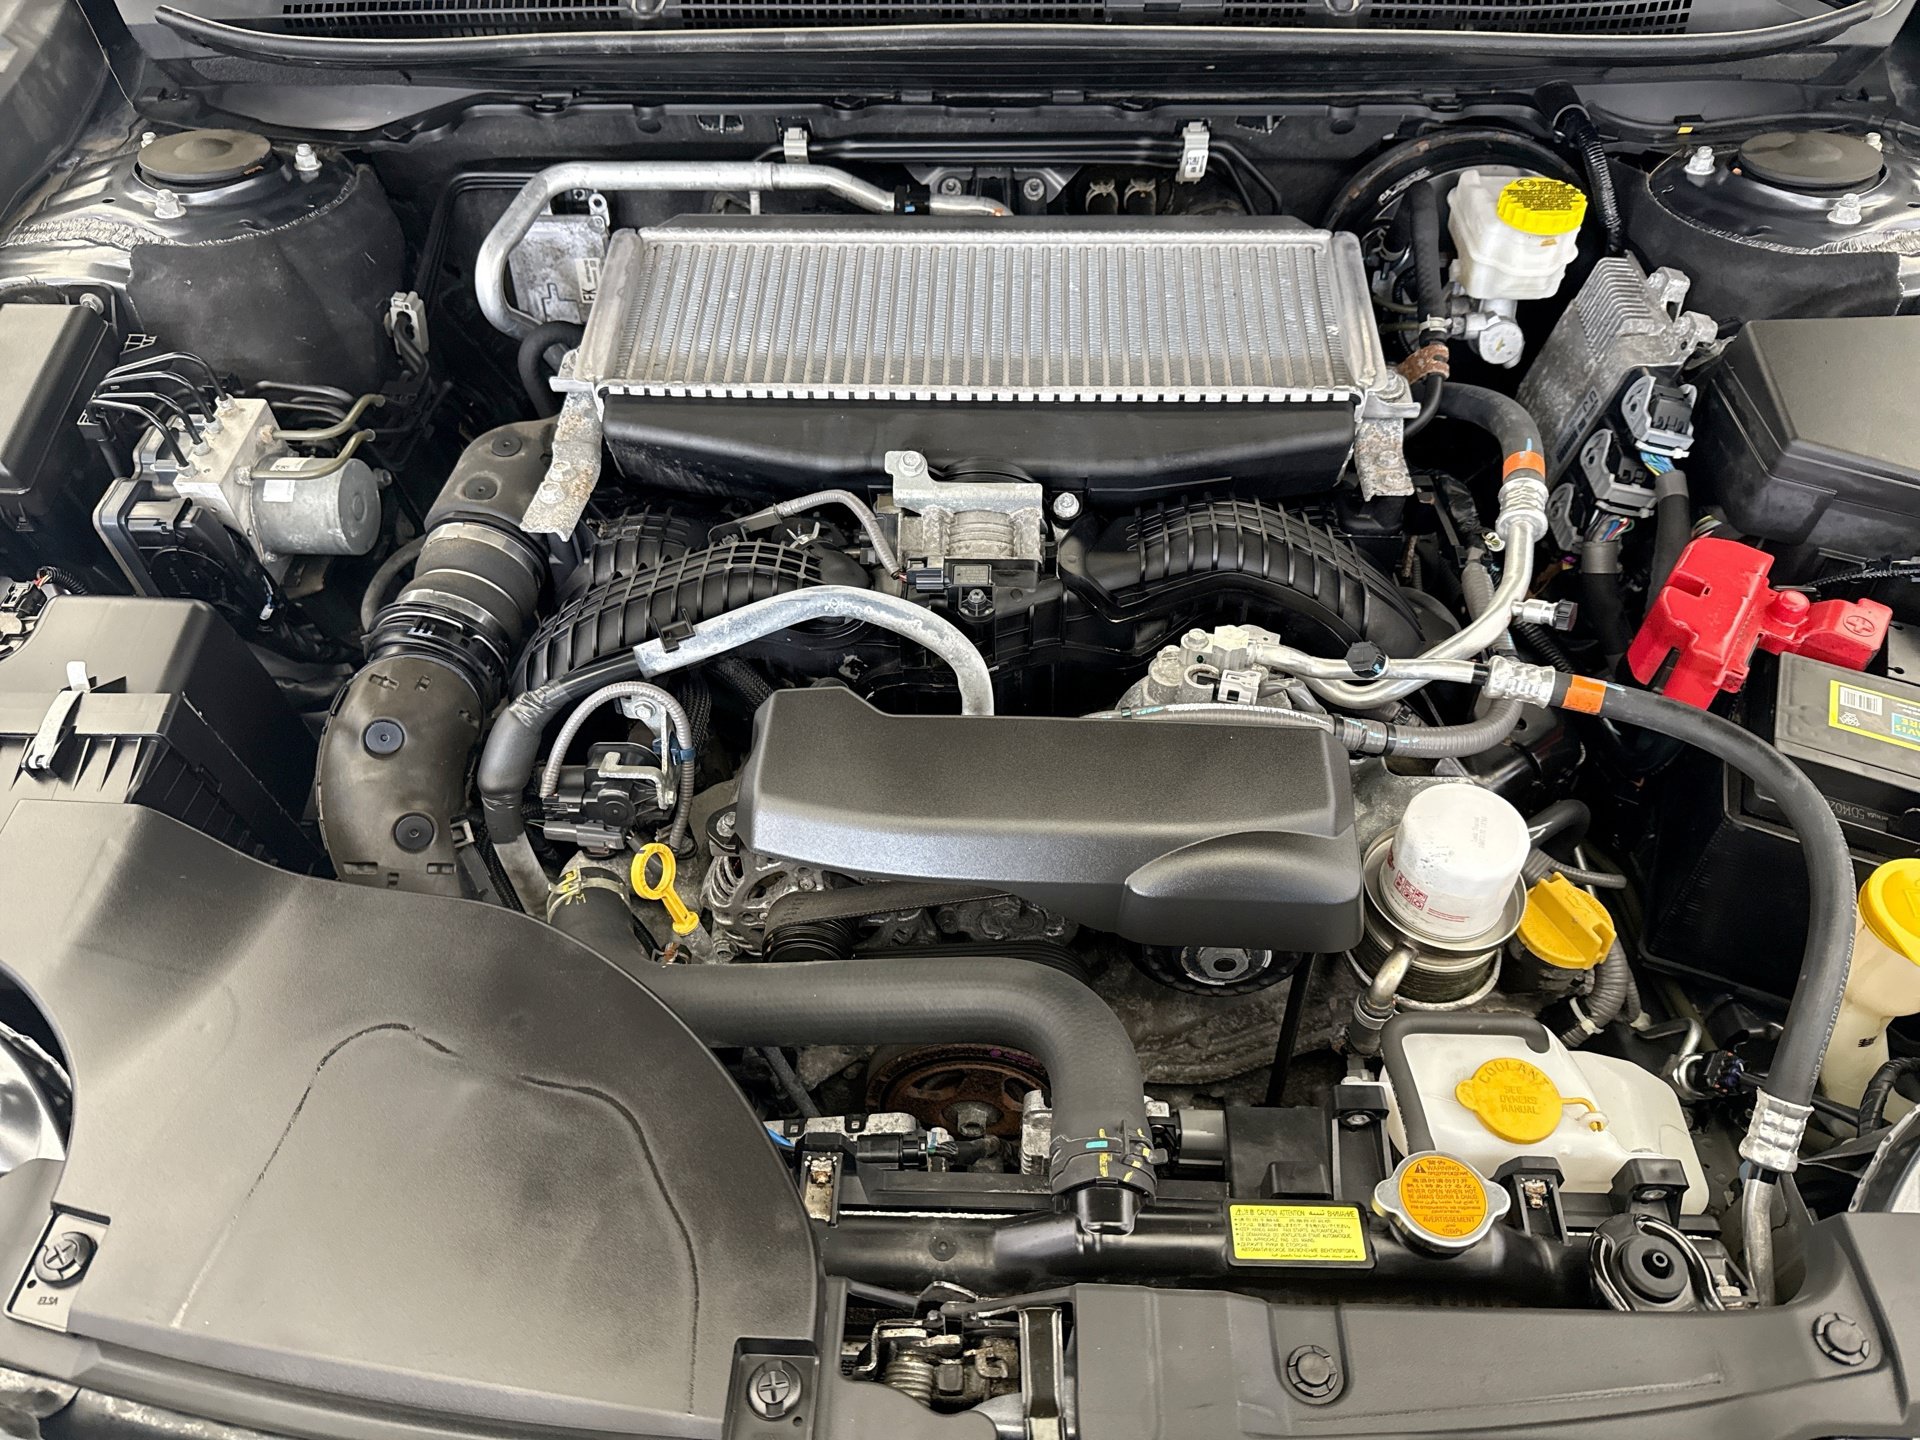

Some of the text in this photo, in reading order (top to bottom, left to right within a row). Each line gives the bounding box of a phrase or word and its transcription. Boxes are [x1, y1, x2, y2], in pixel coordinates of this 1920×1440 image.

[1478, 1060, 1550, 1086] COOLANT
[1501, 1104, 1541, 1115] MANUAL
[1257, 1208, 1278, 1216] CAUTION
[1279, 1209, 1306, 1217] ATTENTION
